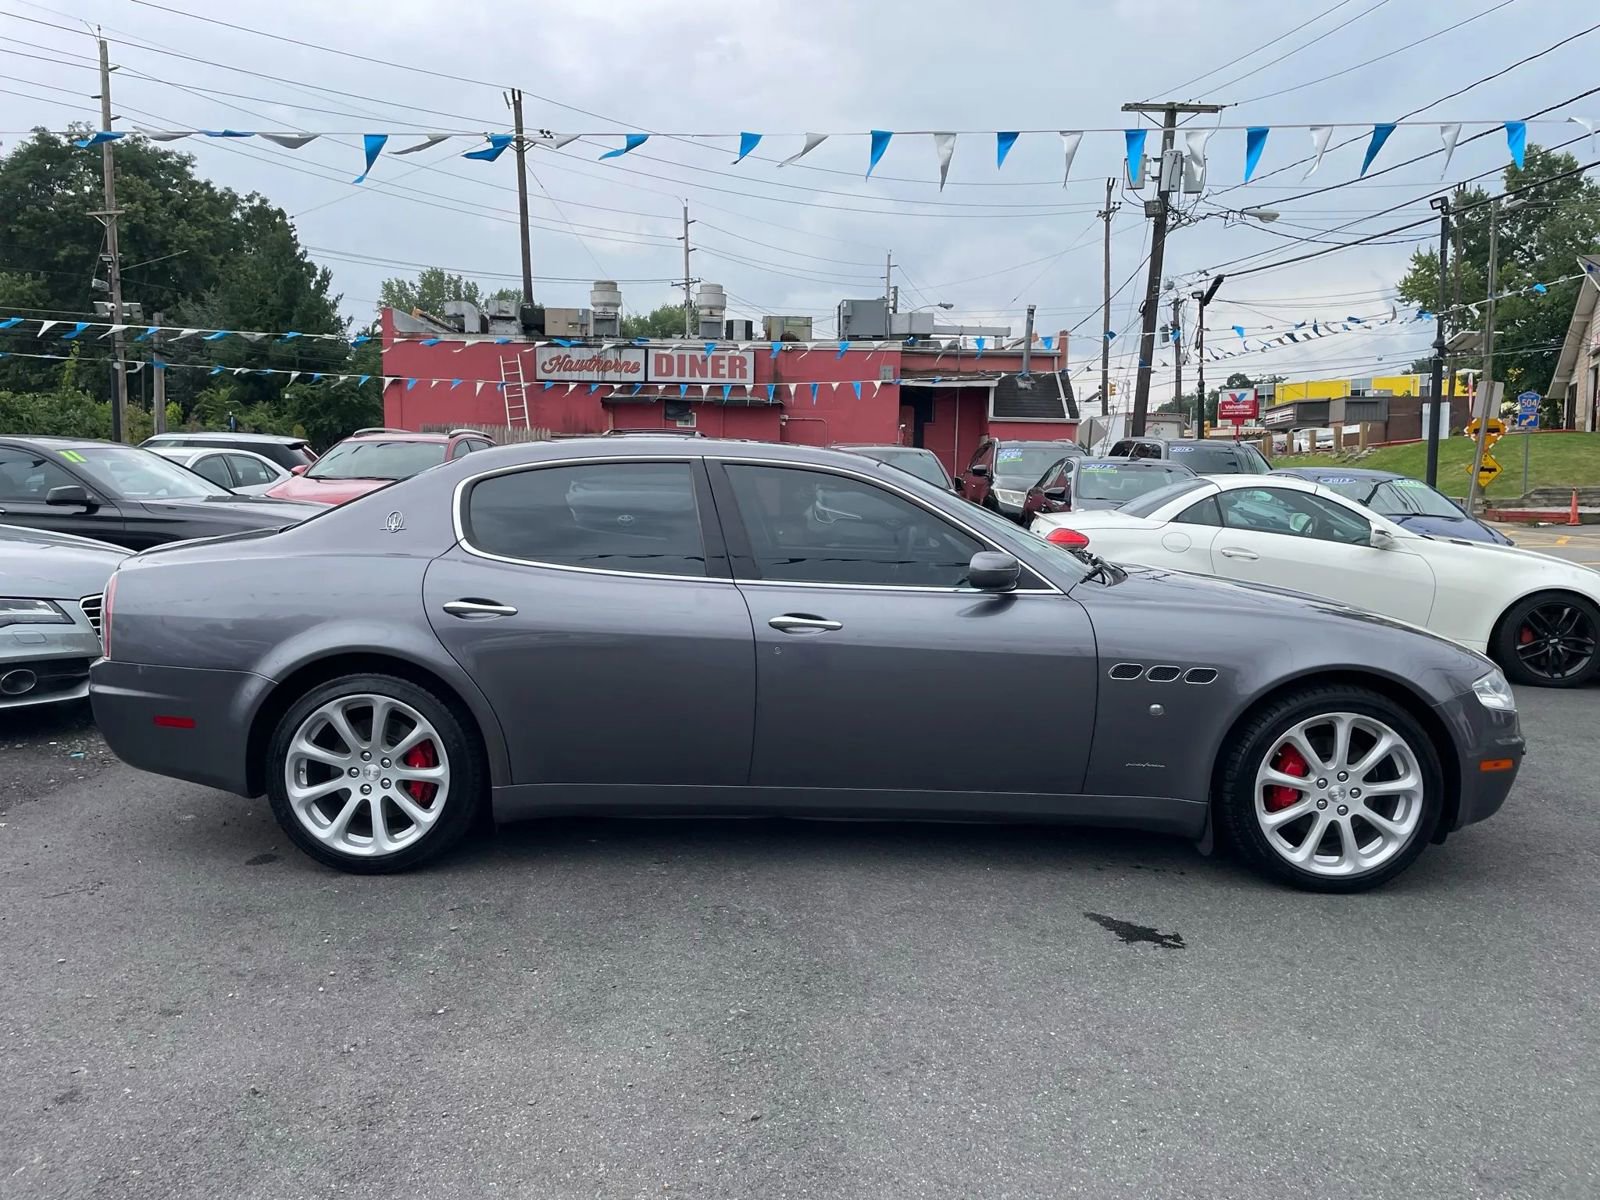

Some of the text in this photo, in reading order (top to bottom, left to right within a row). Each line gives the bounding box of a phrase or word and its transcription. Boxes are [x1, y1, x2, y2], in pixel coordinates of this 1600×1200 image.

[541, 353, 748, 379] Hawthorne DINER
[1521, 398, 1537, 408] 504
[59, 450, 88, 463] 11
